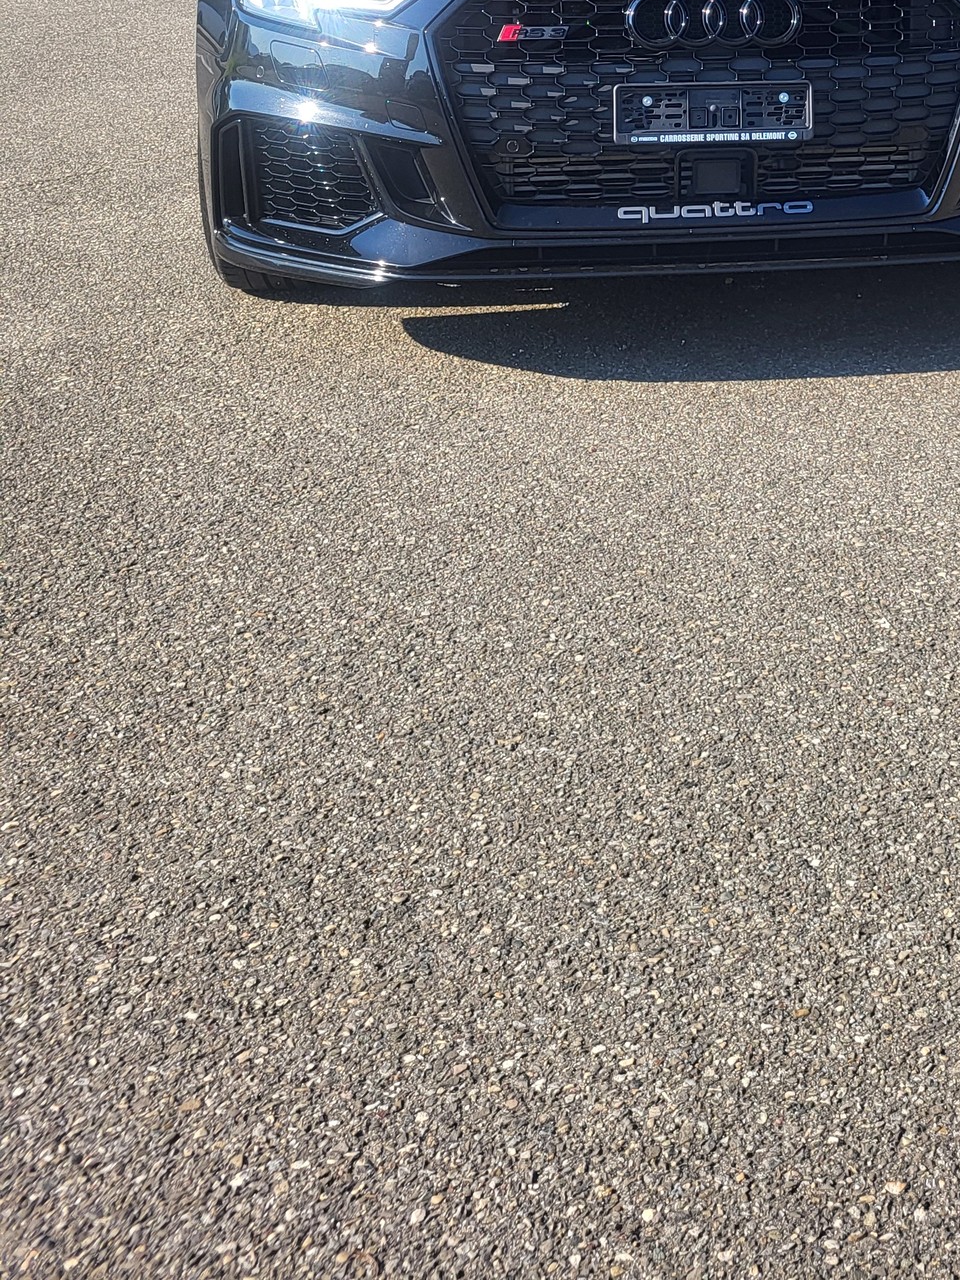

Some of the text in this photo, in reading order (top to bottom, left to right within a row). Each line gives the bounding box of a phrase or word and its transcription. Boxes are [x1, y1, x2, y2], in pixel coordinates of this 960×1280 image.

[660, 134, 705, 143] CARROSSERIE
[706, 133, 739, 142] SPORTING
[740, 132, 750, 141] SA
[751, 131, 786, 140] DELEMONT
[617, 201, 814, 224] quattro
